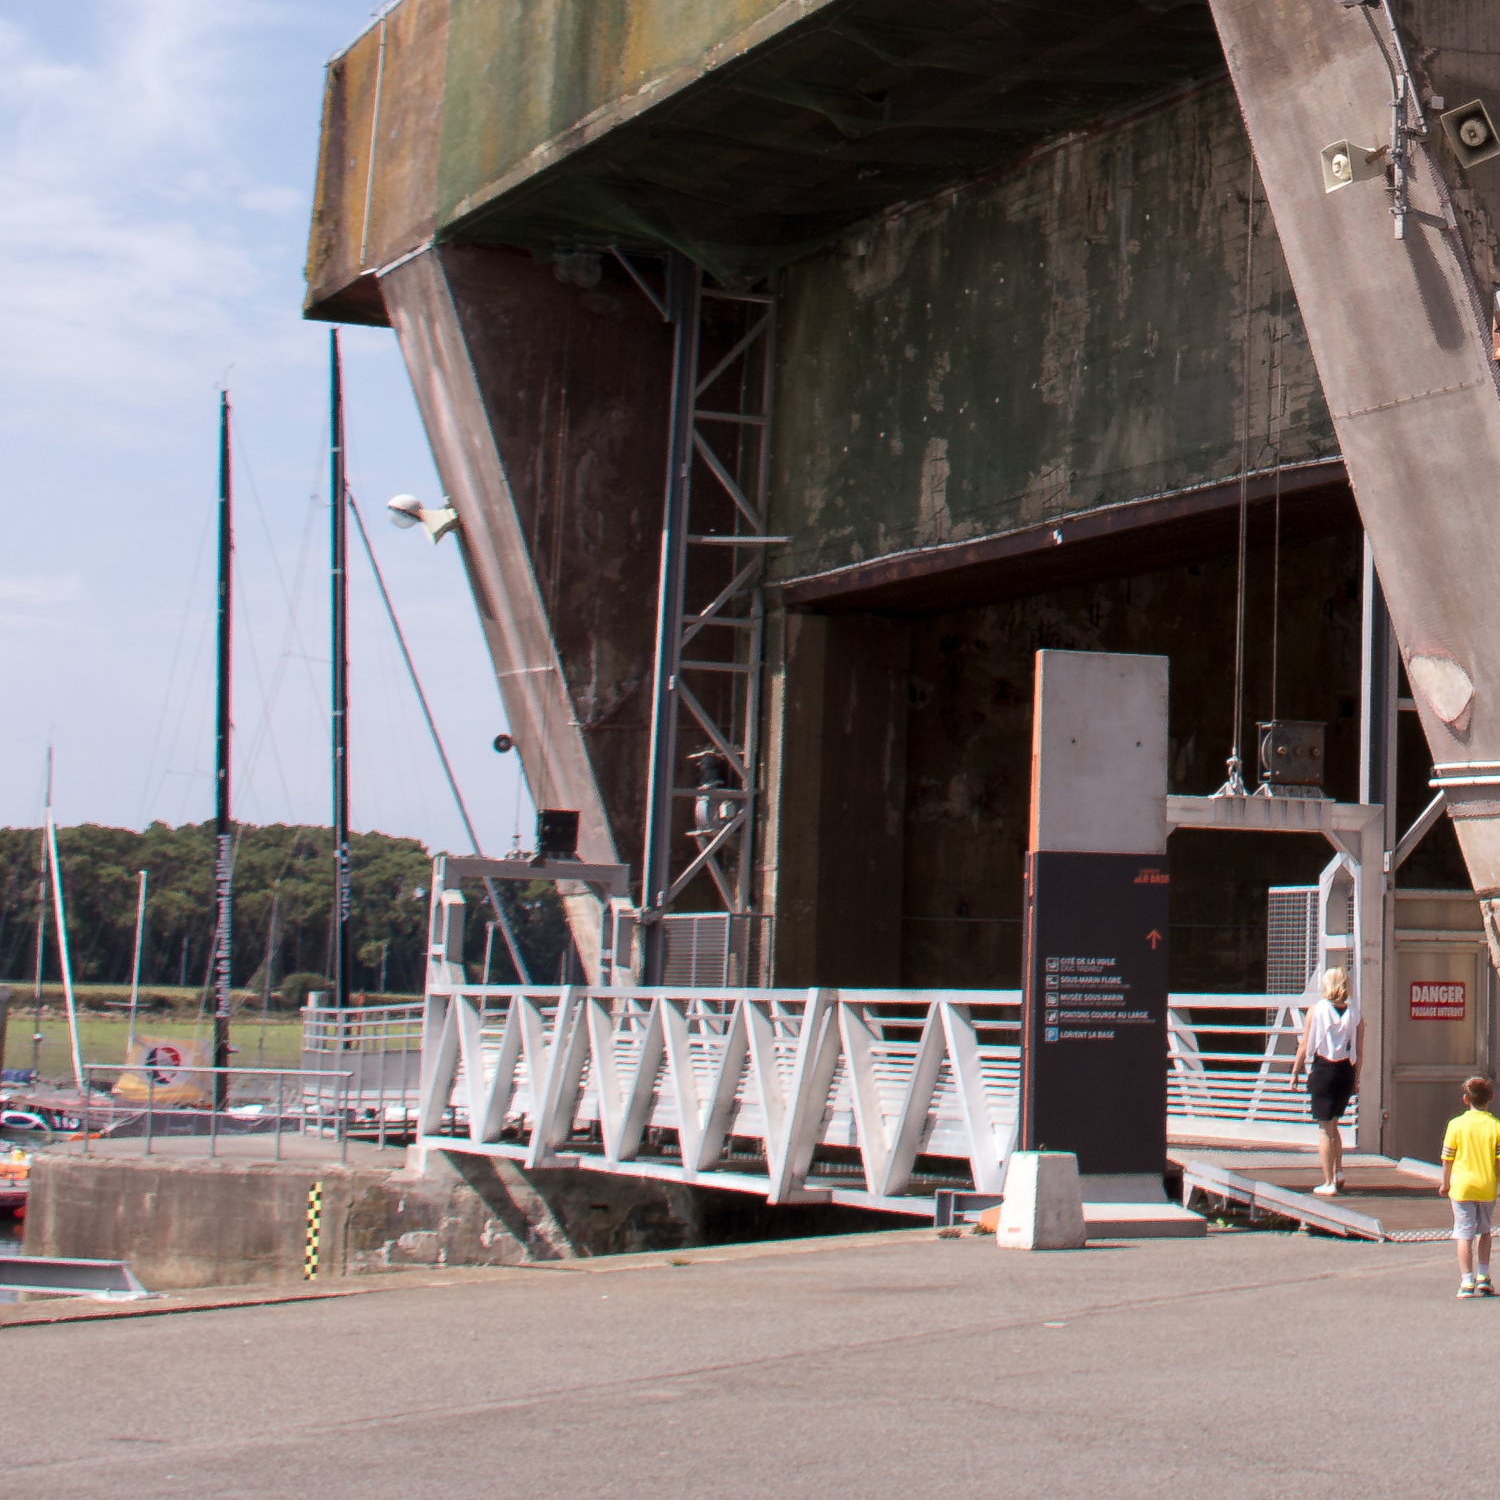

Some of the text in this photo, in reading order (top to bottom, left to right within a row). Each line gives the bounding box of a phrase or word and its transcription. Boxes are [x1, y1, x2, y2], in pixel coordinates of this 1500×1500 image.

[216, 881, 231, 895] du
[215, 959, 231, 972] de
[1097, 958, 1116, 966] VOILE
[1060, 976, 1122, 984] SOUS-MARIN FLORE
[1084, 993, 1124, 1002] SOUS-MARIN
[1412, 985, 1464, 1003] DANGER
[1060, 1011, 1149, 1019] PONTONS COURSE AU LARGE
[1411, 1006, 1464, 1017] PASSAGE INTERDIT
[1060, 1031, 1087, 1039] LORIENT
[1098, 1031, 1115, 1039] BASE
